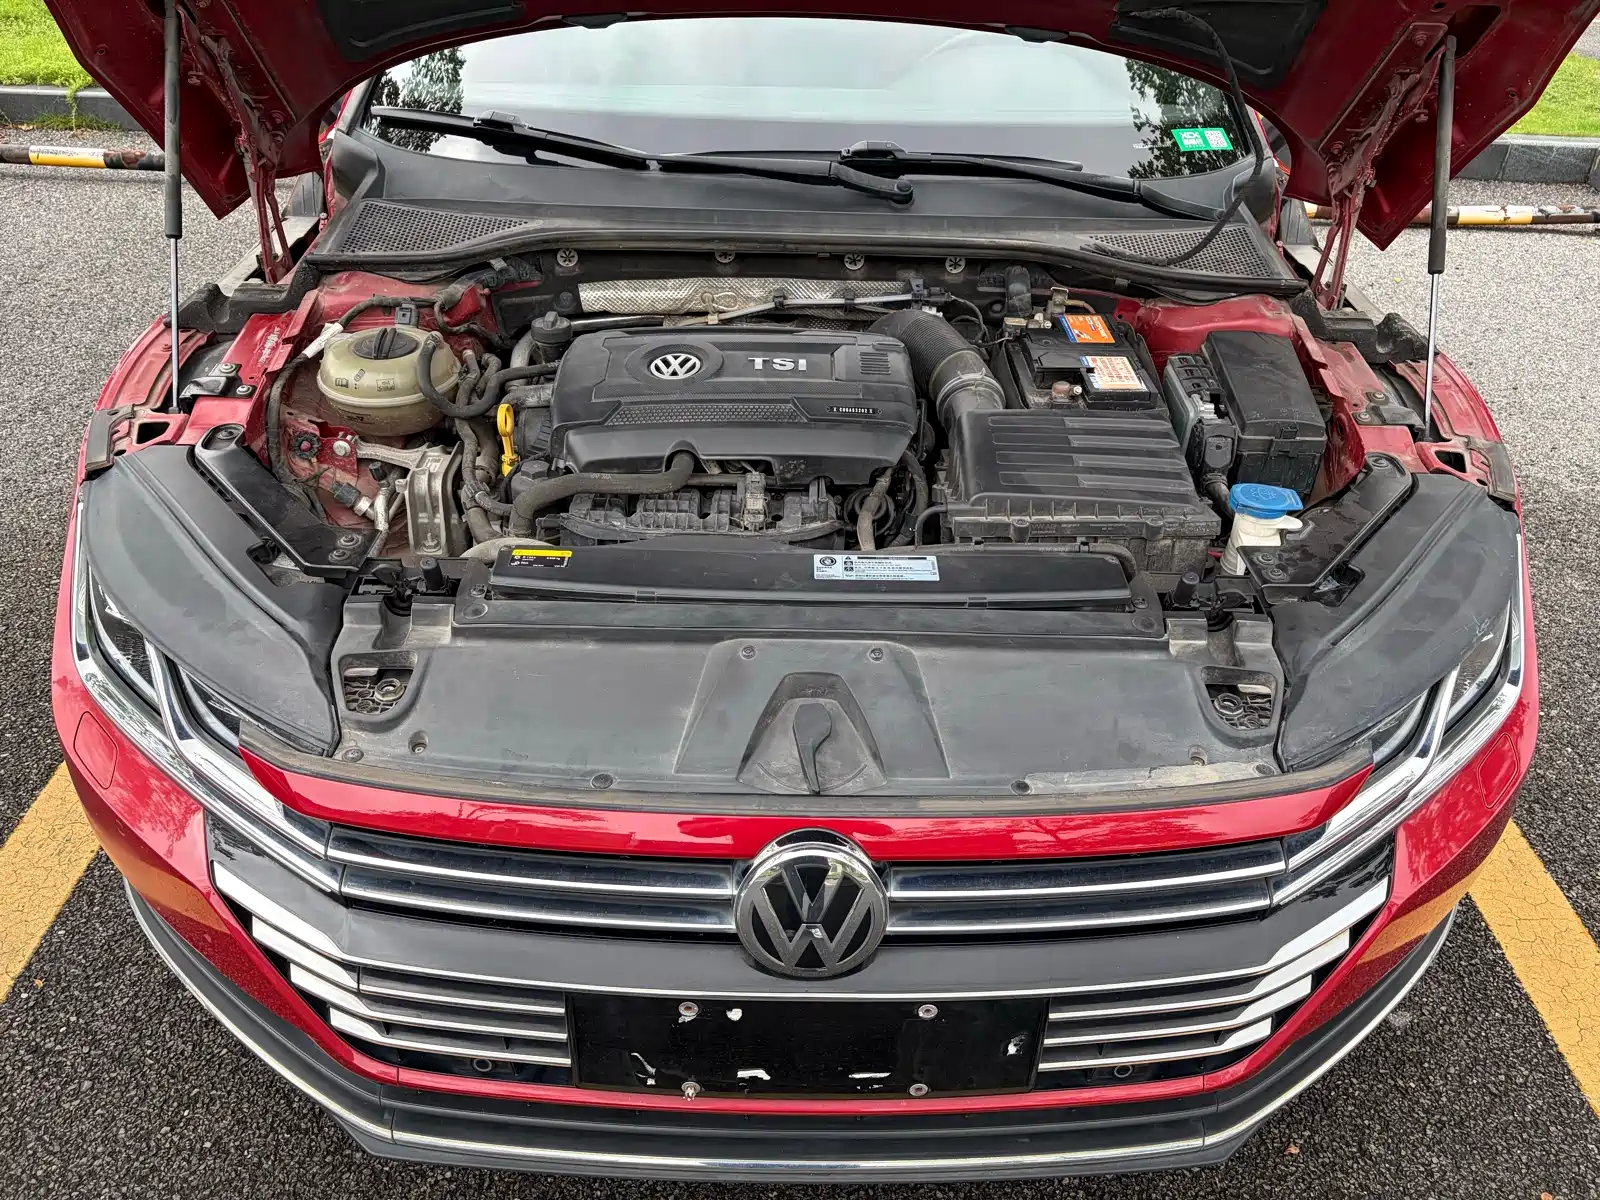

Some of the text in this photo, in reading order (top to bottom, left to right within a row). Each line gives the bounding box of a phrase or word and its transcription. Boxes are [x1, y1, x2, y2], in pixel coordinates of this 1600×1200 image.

[650, 353, 807, 380] VW TSI
[735, 842, 890, 978] VW
